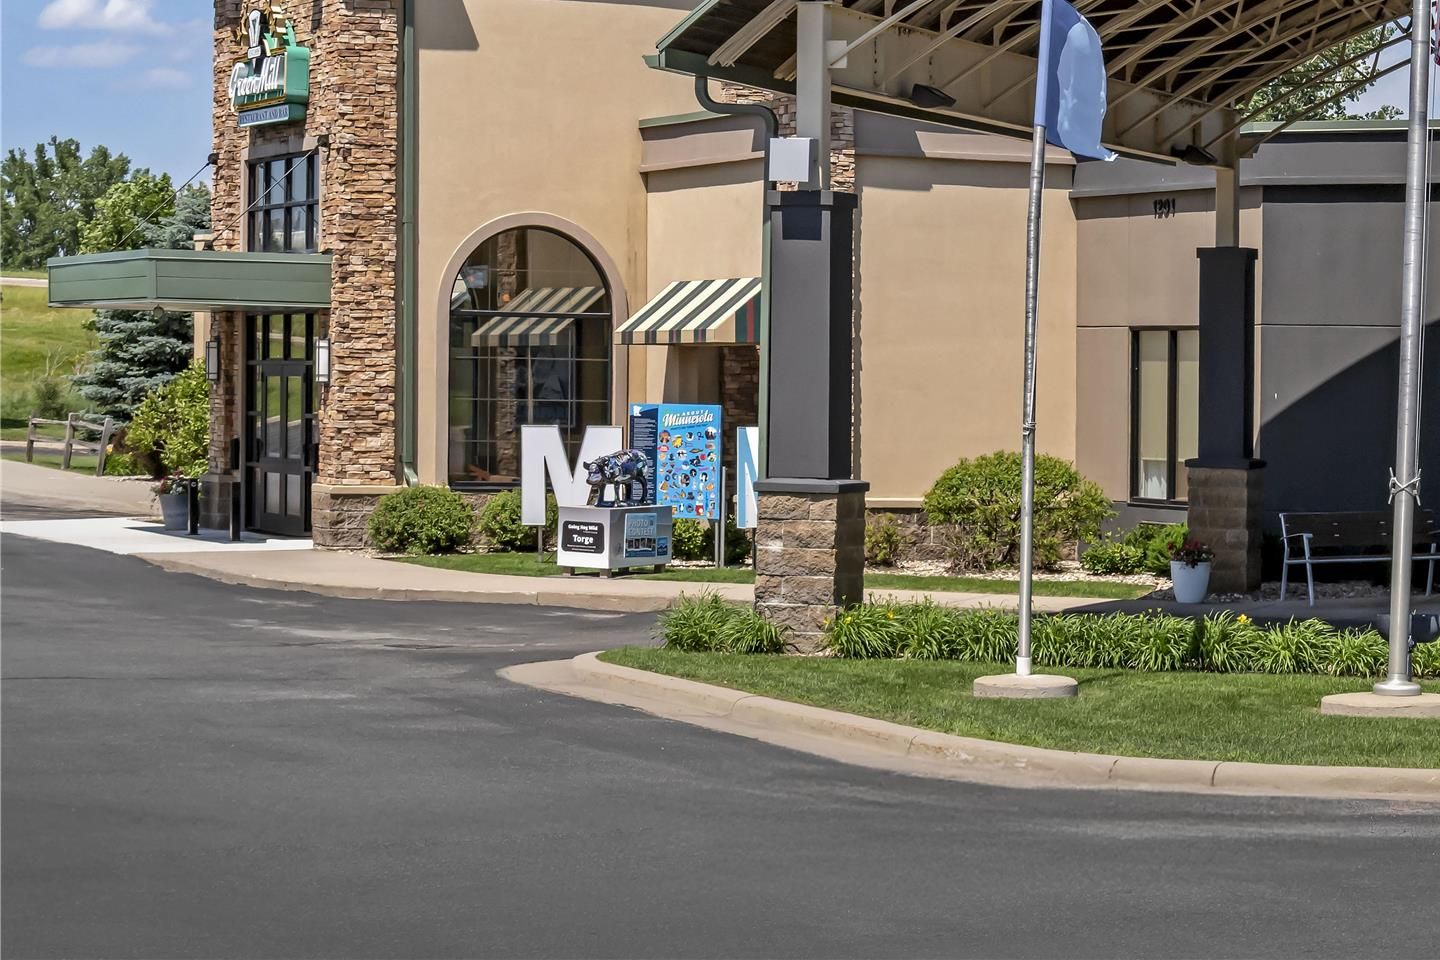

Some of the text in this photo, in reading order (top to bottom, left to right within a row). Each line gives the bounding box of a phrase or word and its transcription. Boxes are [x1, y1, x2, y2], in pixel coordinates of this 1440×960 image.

[229, 55, 281, 112] Green Mill
[662, 409, 714, 427] Minnesota
[573, 534, 594, 545] Torge
